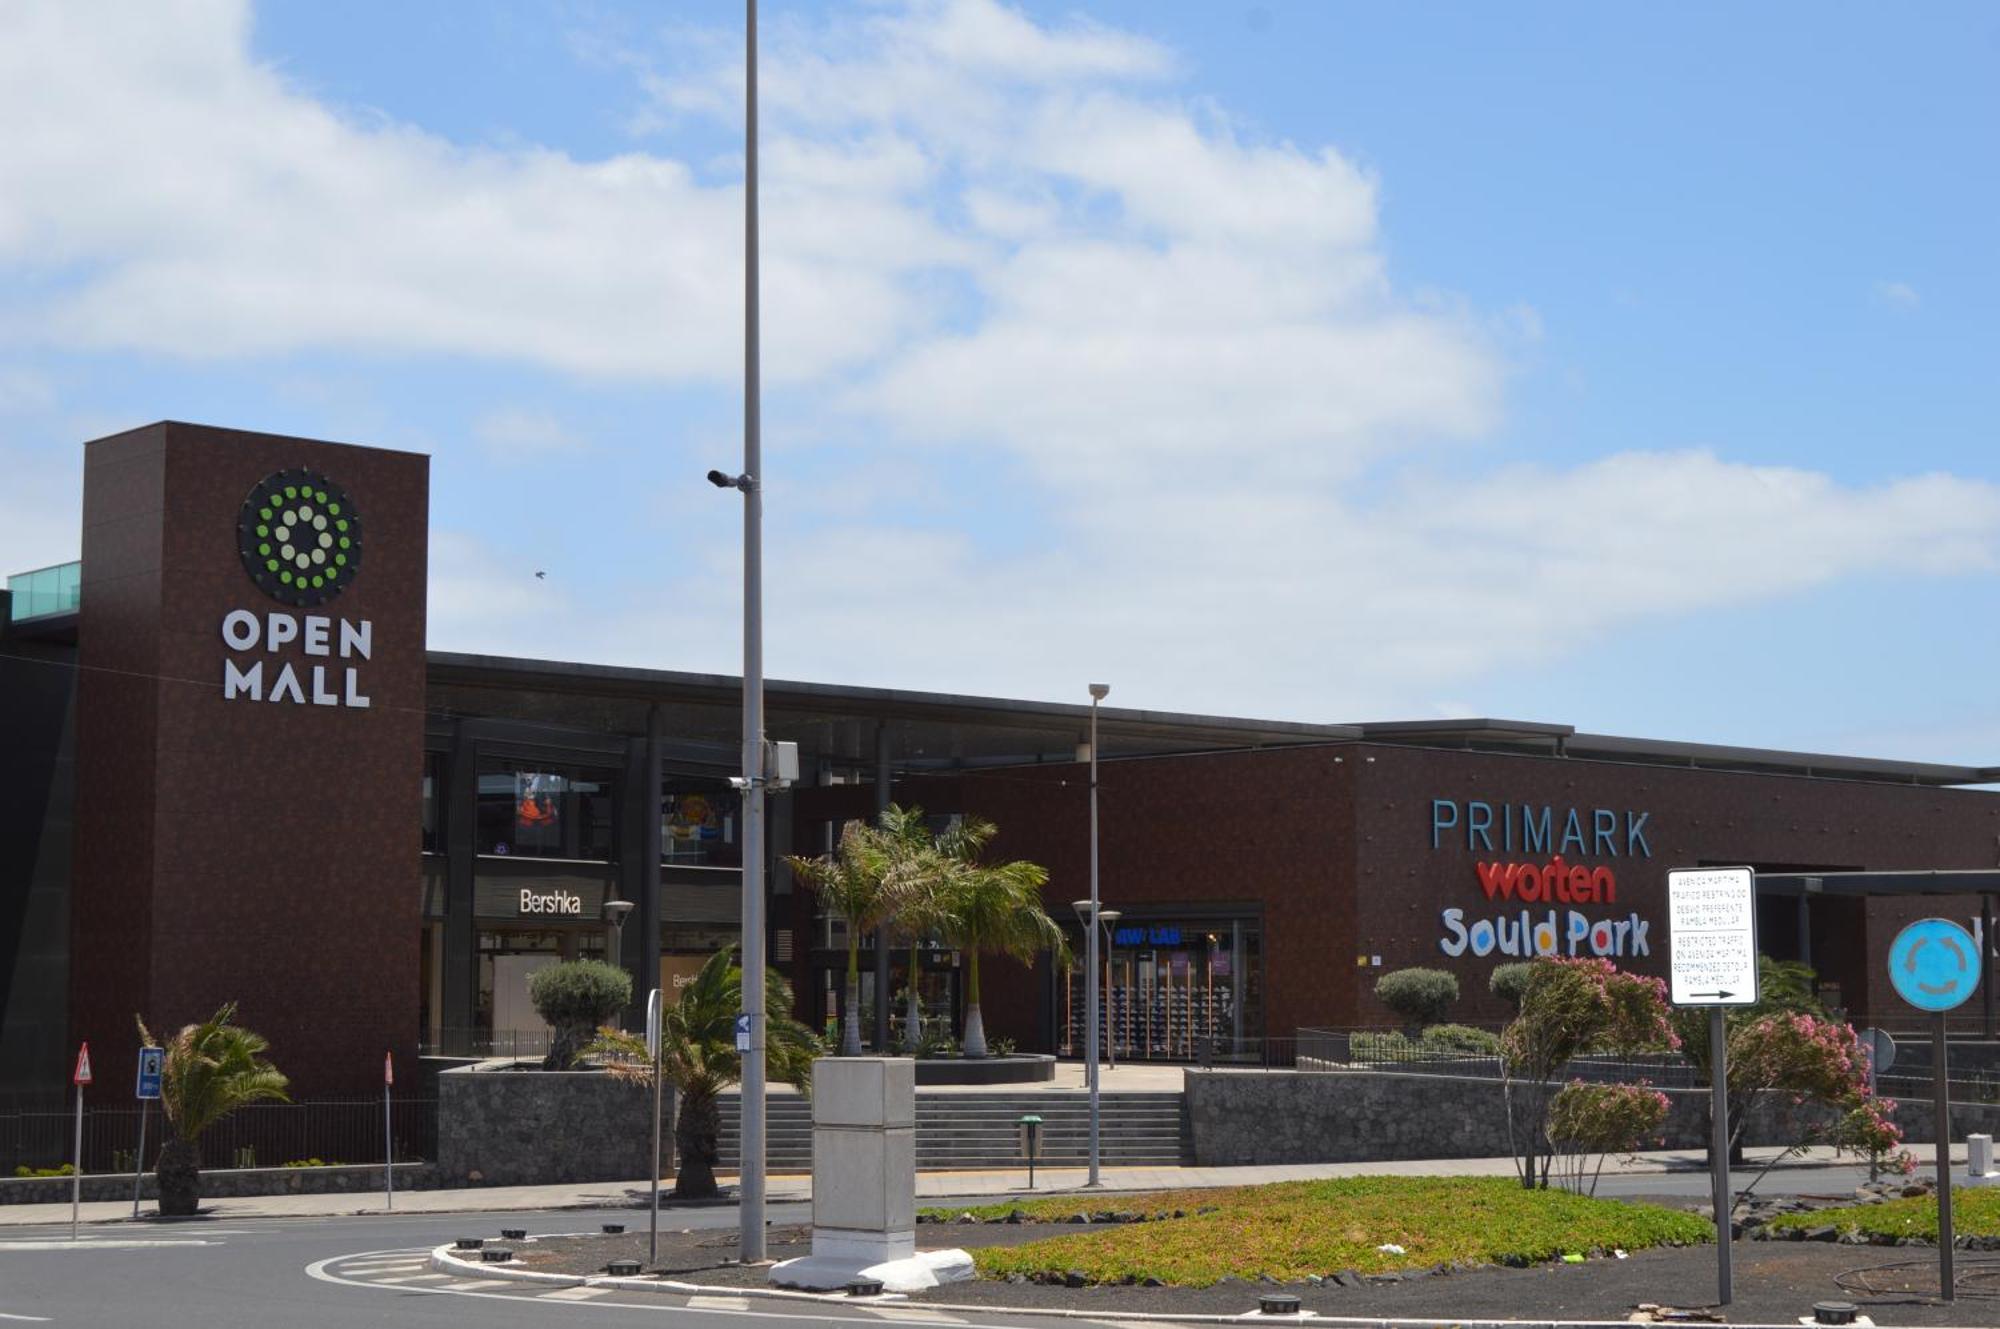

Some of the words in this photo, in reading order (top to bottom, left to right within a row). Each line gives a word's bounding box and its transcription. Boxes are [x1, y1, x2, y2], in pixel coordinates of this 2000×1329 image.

[222, 609, 371, 660] OPEN
[224, 658, 370, 707] MALL
[1432, 799, 1650, 857] PRIMARK
[520, 888, 581, 914] Bershka
[1476, 855, 1617, 903] worten
[1440, 908, 1558, 957] Sould
[1567, 909, 1650, 957] Park
